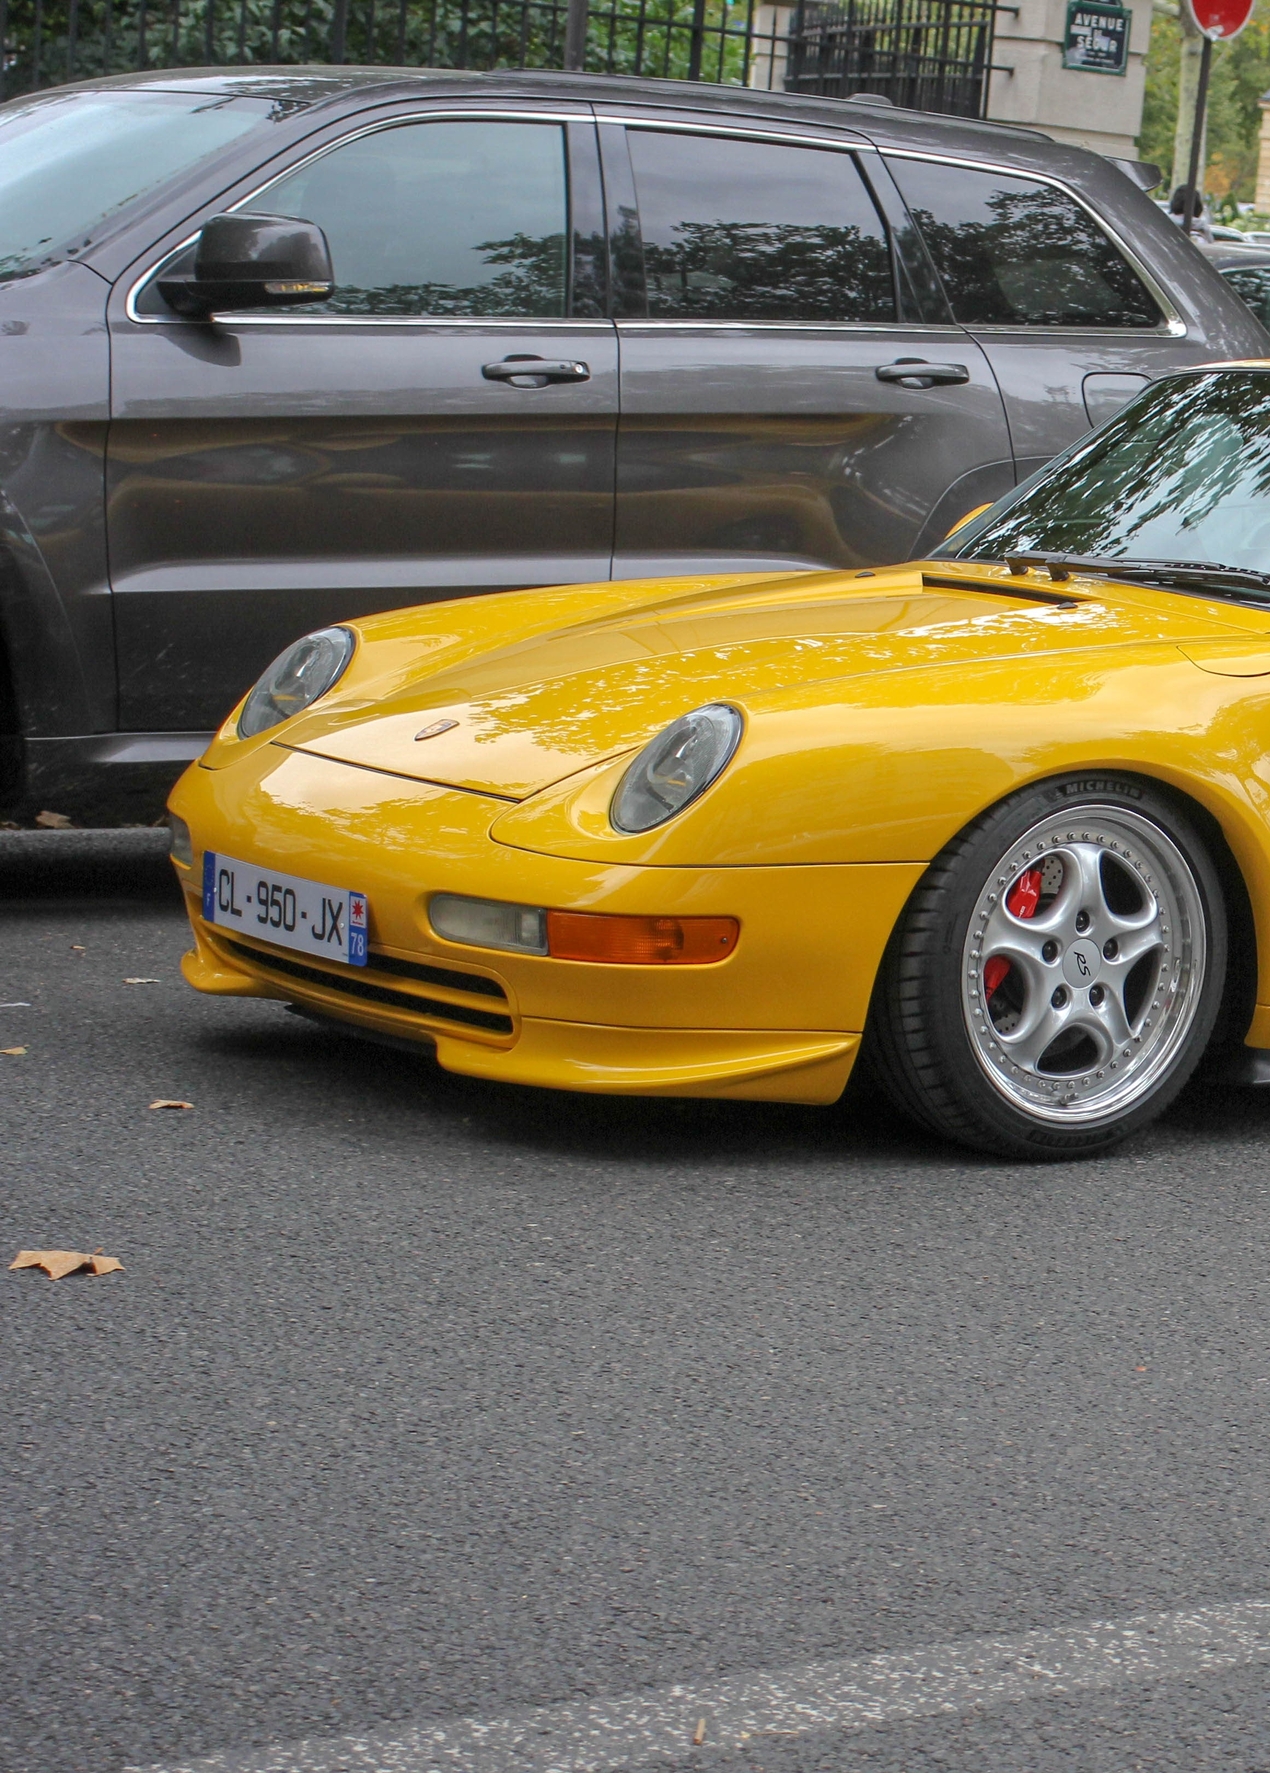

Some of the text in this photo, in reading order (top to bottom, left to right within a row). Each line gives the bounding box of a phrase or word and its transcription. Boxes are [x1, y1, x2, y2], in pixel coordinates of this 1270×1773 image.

[1074, 12, 1124, 32] AVENUE
[1065, 780, 1141, 799] MICHELIN
[350, 931, 365, 957] 78
[1073, 950, 1092, 977] RS
